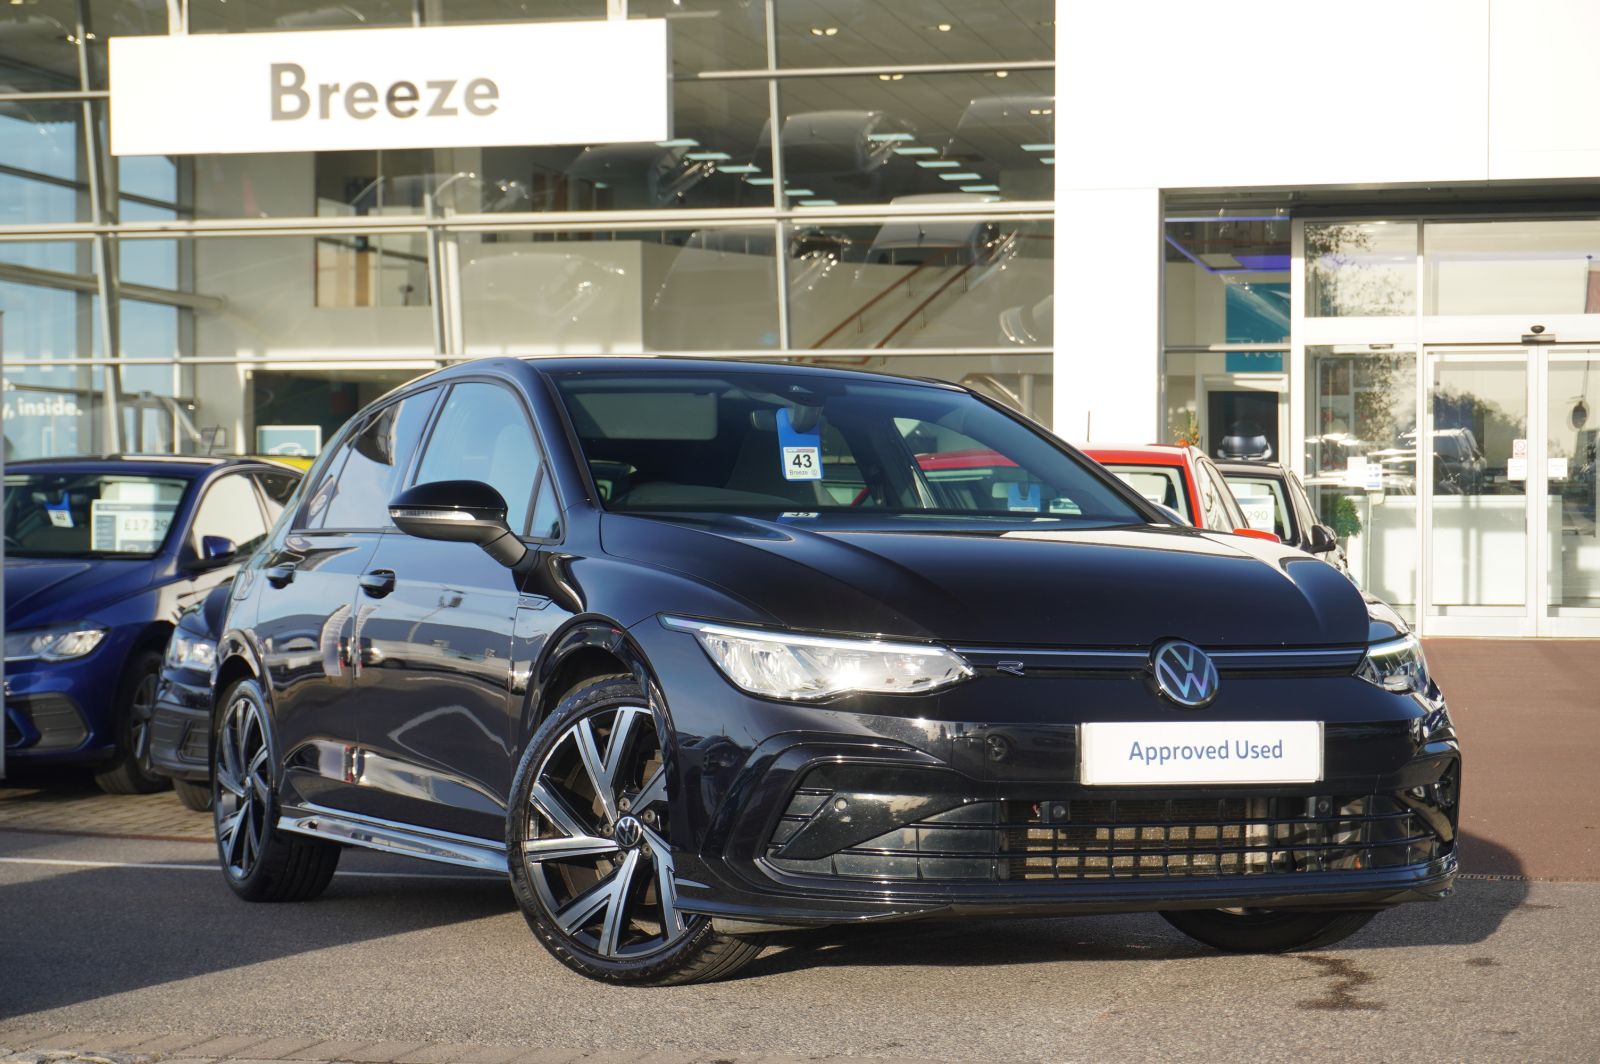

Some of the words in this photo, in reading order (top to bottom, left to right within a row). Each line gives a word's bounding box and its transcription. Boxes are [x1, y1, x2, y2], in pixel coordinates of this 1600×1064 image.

[269, 62, 500, 121] Breeze
[17, 395, 83, 417] inside.
[793, 454, 812, 468] 43
[1128, 740, 1229, 766] Approved
[1235, 739, 1284, 760] Used
